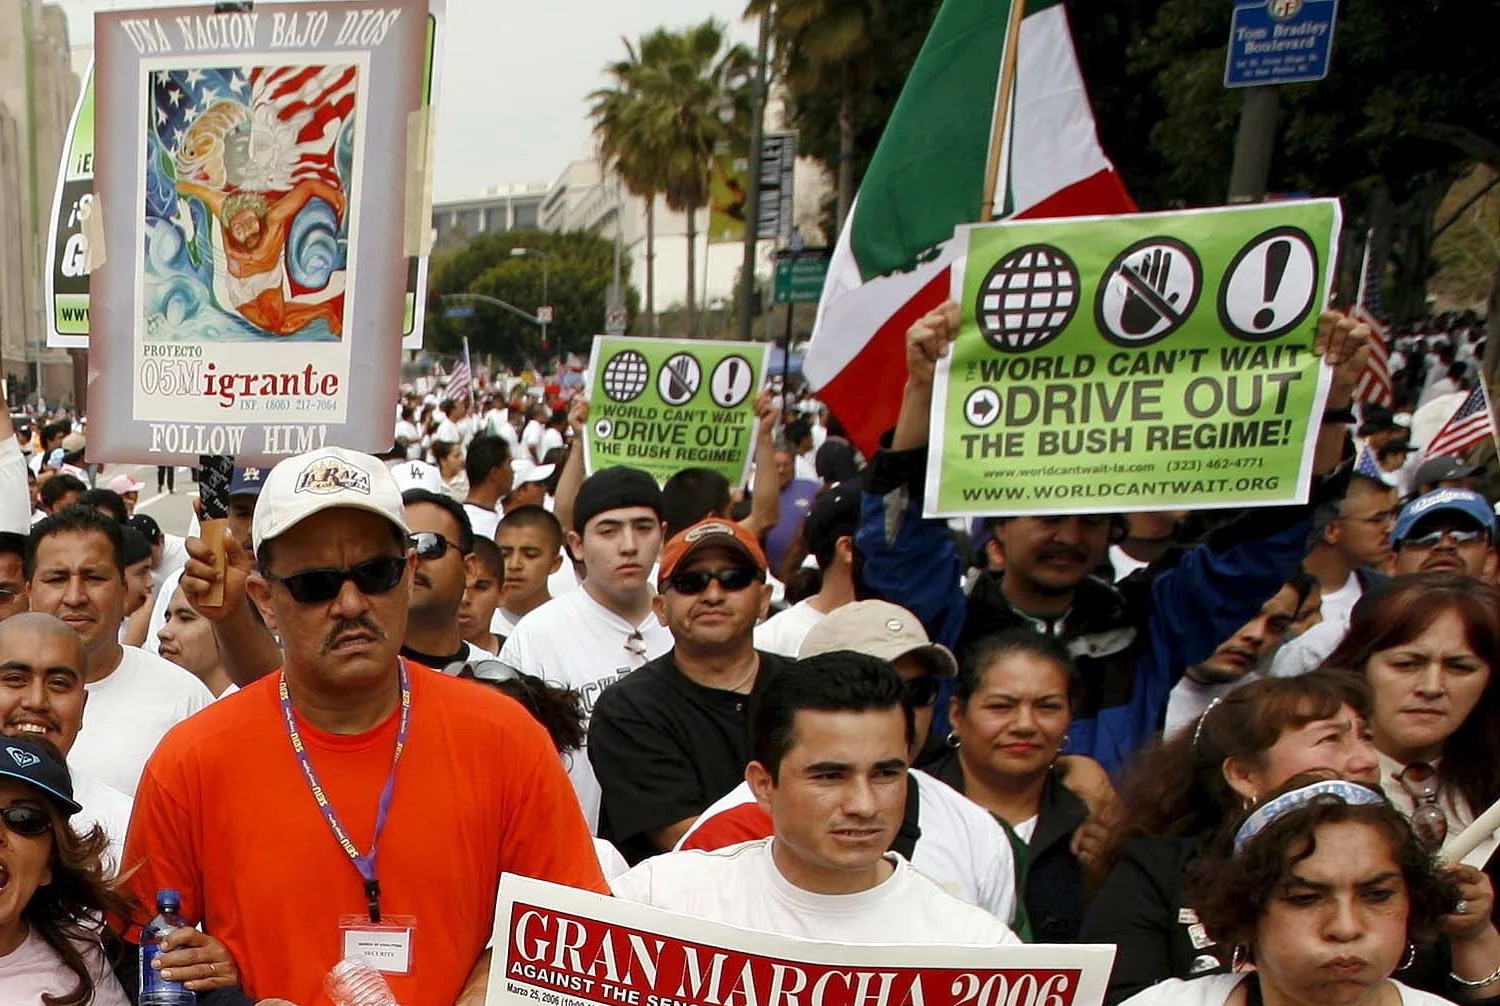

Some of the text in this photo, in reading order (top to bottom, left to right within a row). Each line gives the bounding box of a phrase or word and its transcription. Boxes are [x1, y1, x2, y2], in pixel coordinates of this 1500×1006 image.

[120, 7, 402, 55] UNA NACION BAJO DIOS
[1236, 21, 1329, 41] Tom Bradley
[1244, 36, 1317, 55] Boulevard
[143, 344, 203, 358] PROYECTO
[978, 344, 1306, 383] WORLD CAN'T WAIT
[1004, 371, 1303, 428] DRIVE OUT
[603, 404, 748, 425] WORLD CAN'T WAIT
[149, 424, 327, 455] FOLLOW HIM!
[612, 420, 746, 447] DRIVE OUT
[960, 418, 1293, 460] THE BUSH REGIME!
[594, 441, 741, 463] THE BUSH REGIME!
[410, 464, 424, 479] LA
[983, 456, 1265, 479] www.worldcantwait-la.com (323) 462-4771
[962, 477, 1279, 502] WWW.WORLDCANTWAIT.ORG
[340, 837, 360, 859] SEIU
[515, 910, 665, 991] GRAN
[506, 983, 529, 999] Marzo
[530, 989, 541, 1002] 25,
[542, 991, 560, 1006] 2006
[510, 962, 595, 994] AGAINST
[601, 983, 640, 1006] THE
